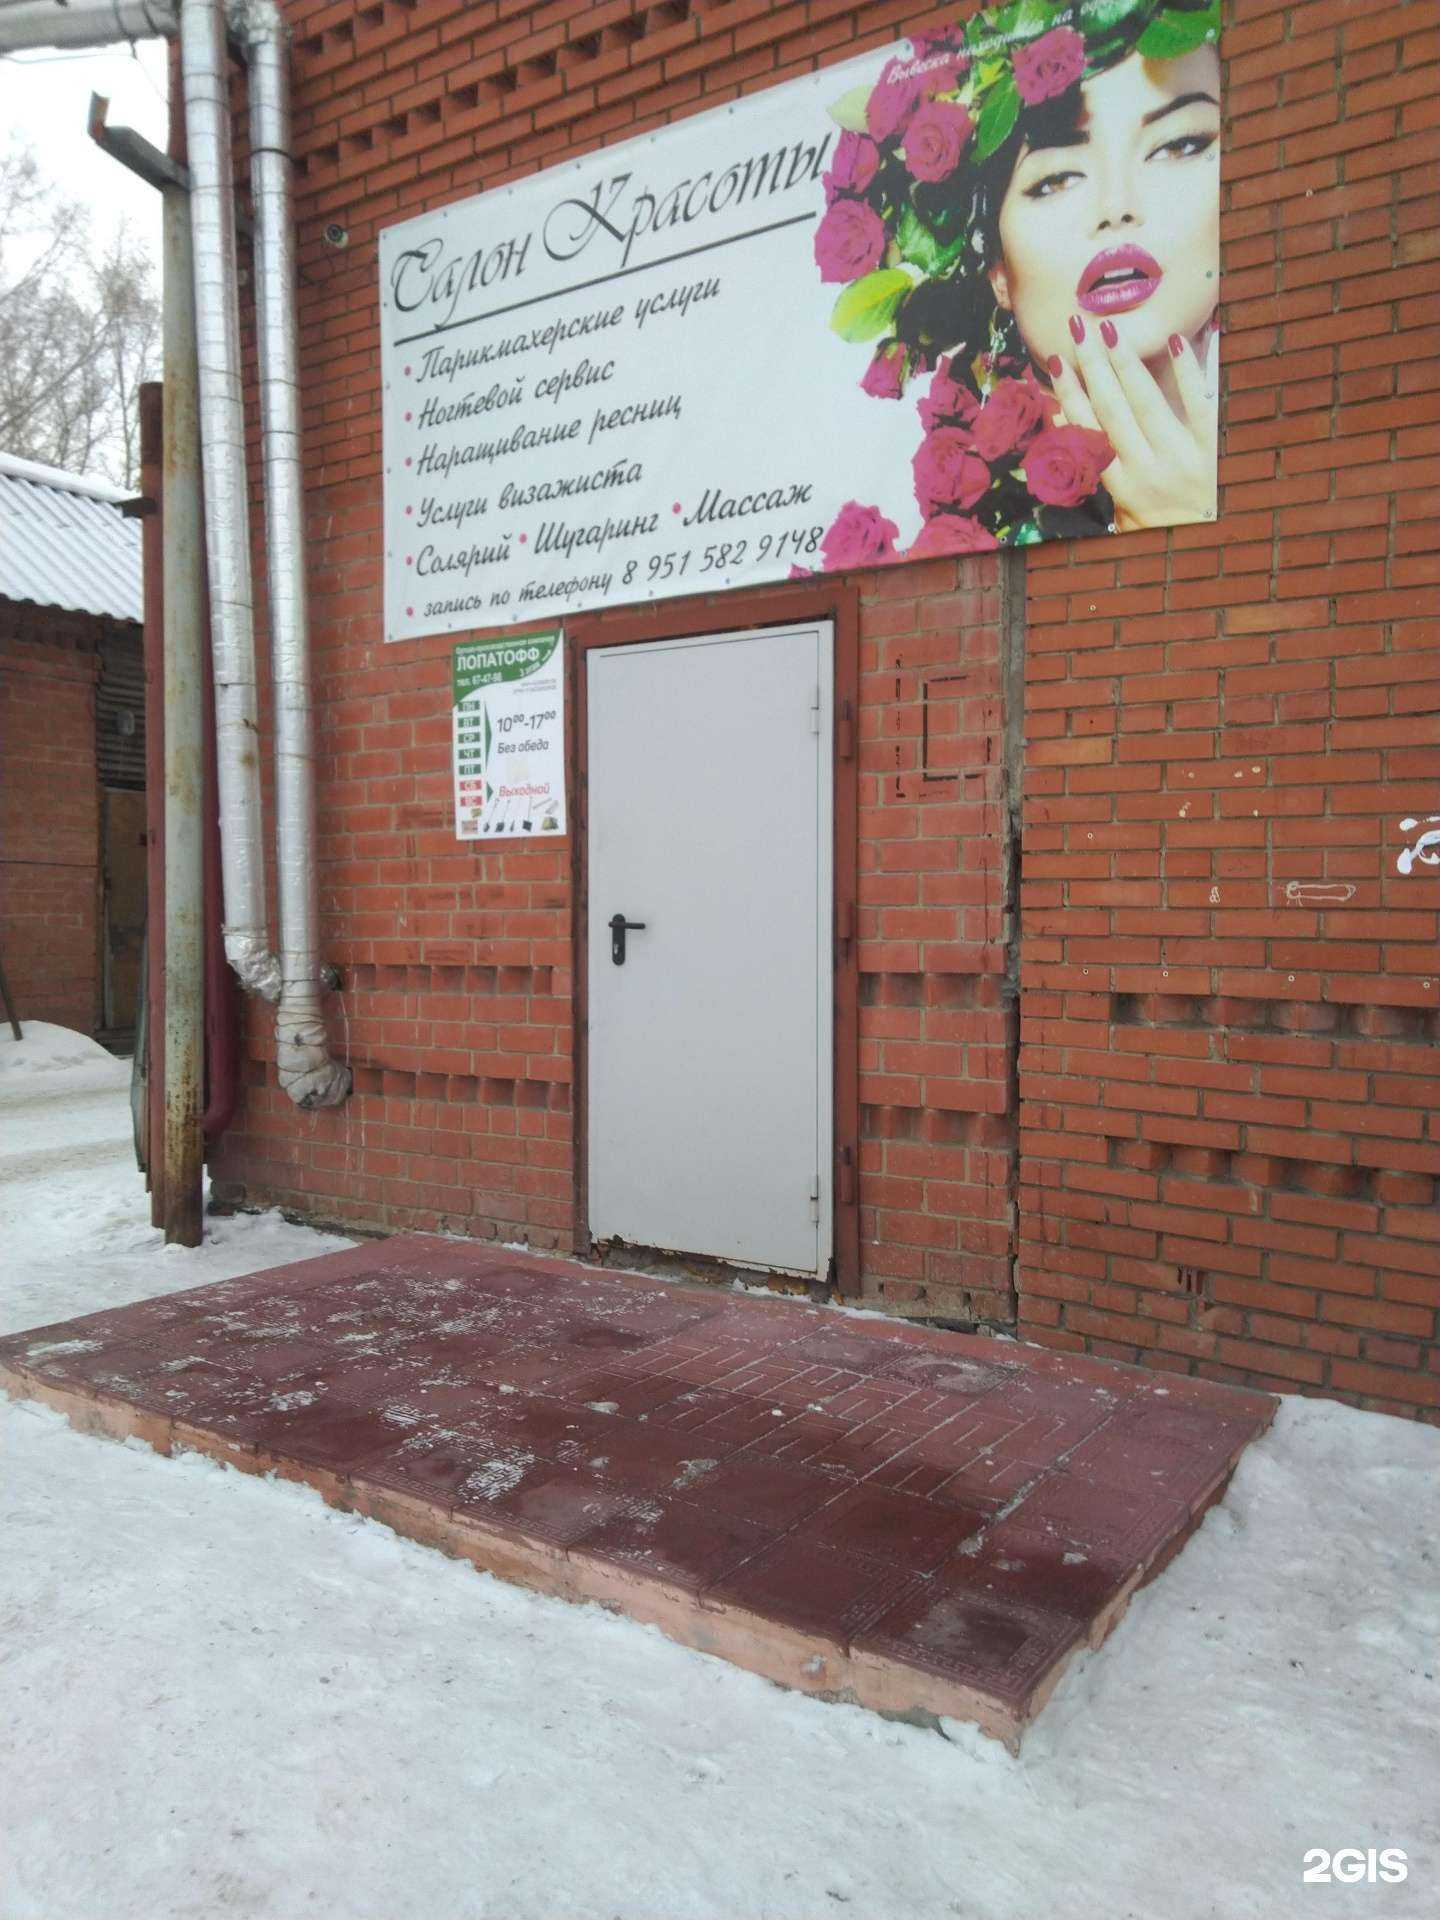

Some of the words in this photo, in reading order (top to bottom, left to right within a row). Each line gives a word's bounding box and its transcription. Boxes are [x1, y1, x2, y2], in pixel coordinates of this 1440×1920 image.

[391, 234, 533, 331] Салон
[543, 133, 833, 266] Красоты
[416, 305, 625, 382] Парикмахерские
[634, 278, 720, 328] услуги
[418, 376, 525, 429] Ногтевой
[534, 359, 615, 404] сервис
[416, 418, 581, 478] Наращивание
[588, 395, 682, 444] ресниц
[416, 498, 488, 529] Услуги
[498, 459, 643, 511] визажиста
[416, 535, 510, 576] Солярий
[534, 512, 659, 557] Шугаринг
[683, 482, 813, 528] Массаж
[423, 594, 483, 618] запись
[489, 591, 510, 608] по
[518, 570, 613, 604] телефону
[622, 560, 637, 585] 8
[646, 550, 692, 579] 951
[699, 539, 744, 572] 582
[756, 526, 824, 562] 9148
[457, 647, 540, 672] ЛОПАТОФФ
[497, 742, 516, 754] Без
[518, 739, 549, 752] обеда
[499, 782, 550, 797] Выходной
